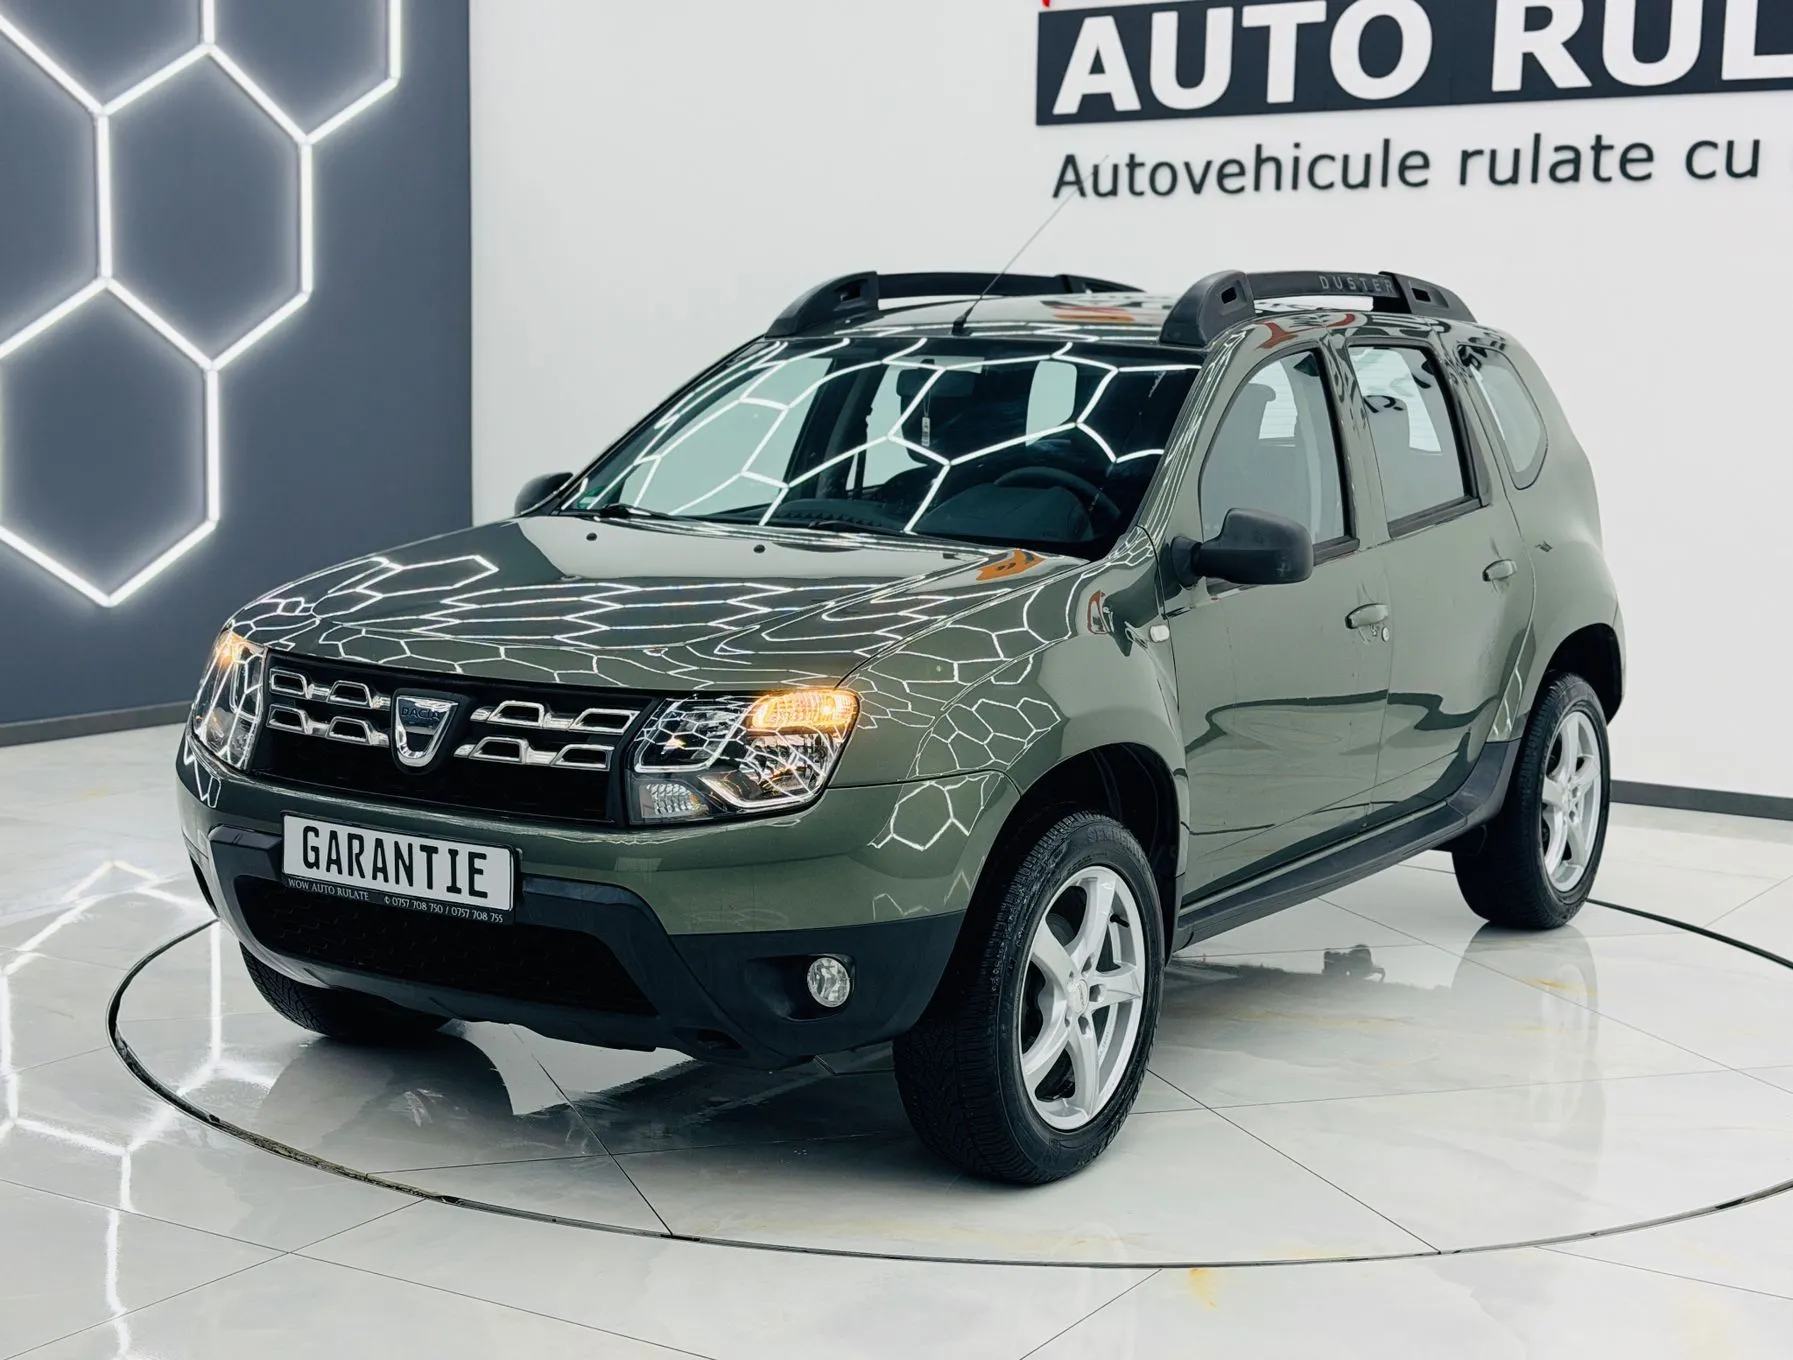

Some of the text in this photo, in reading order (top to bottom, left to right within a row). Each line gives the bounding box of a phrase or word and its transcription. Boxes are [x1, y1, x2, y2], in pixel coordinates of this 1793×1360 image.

[1052, 0, 1793, 115] AUTO RUL
[1052, 132, 1760, 199] Autovehicule rulate cu
[1318, 274, 1396, 294] DUSTER
[302, 826, 489, 899] GARANTIE
[288, 878, 309, 890] WOW
[311, 883, 335, 895] AUTO
[337, 887, 369, 901] RULATE
[392, 897, 410, 908] 0757
[412, 900, 428, 911] 708
[429, 903, 443, 914] 750
[451, 906, 470, 918] 0757
[472, 910, 488, 921] 708
[490, 912, 504, 923] 755
